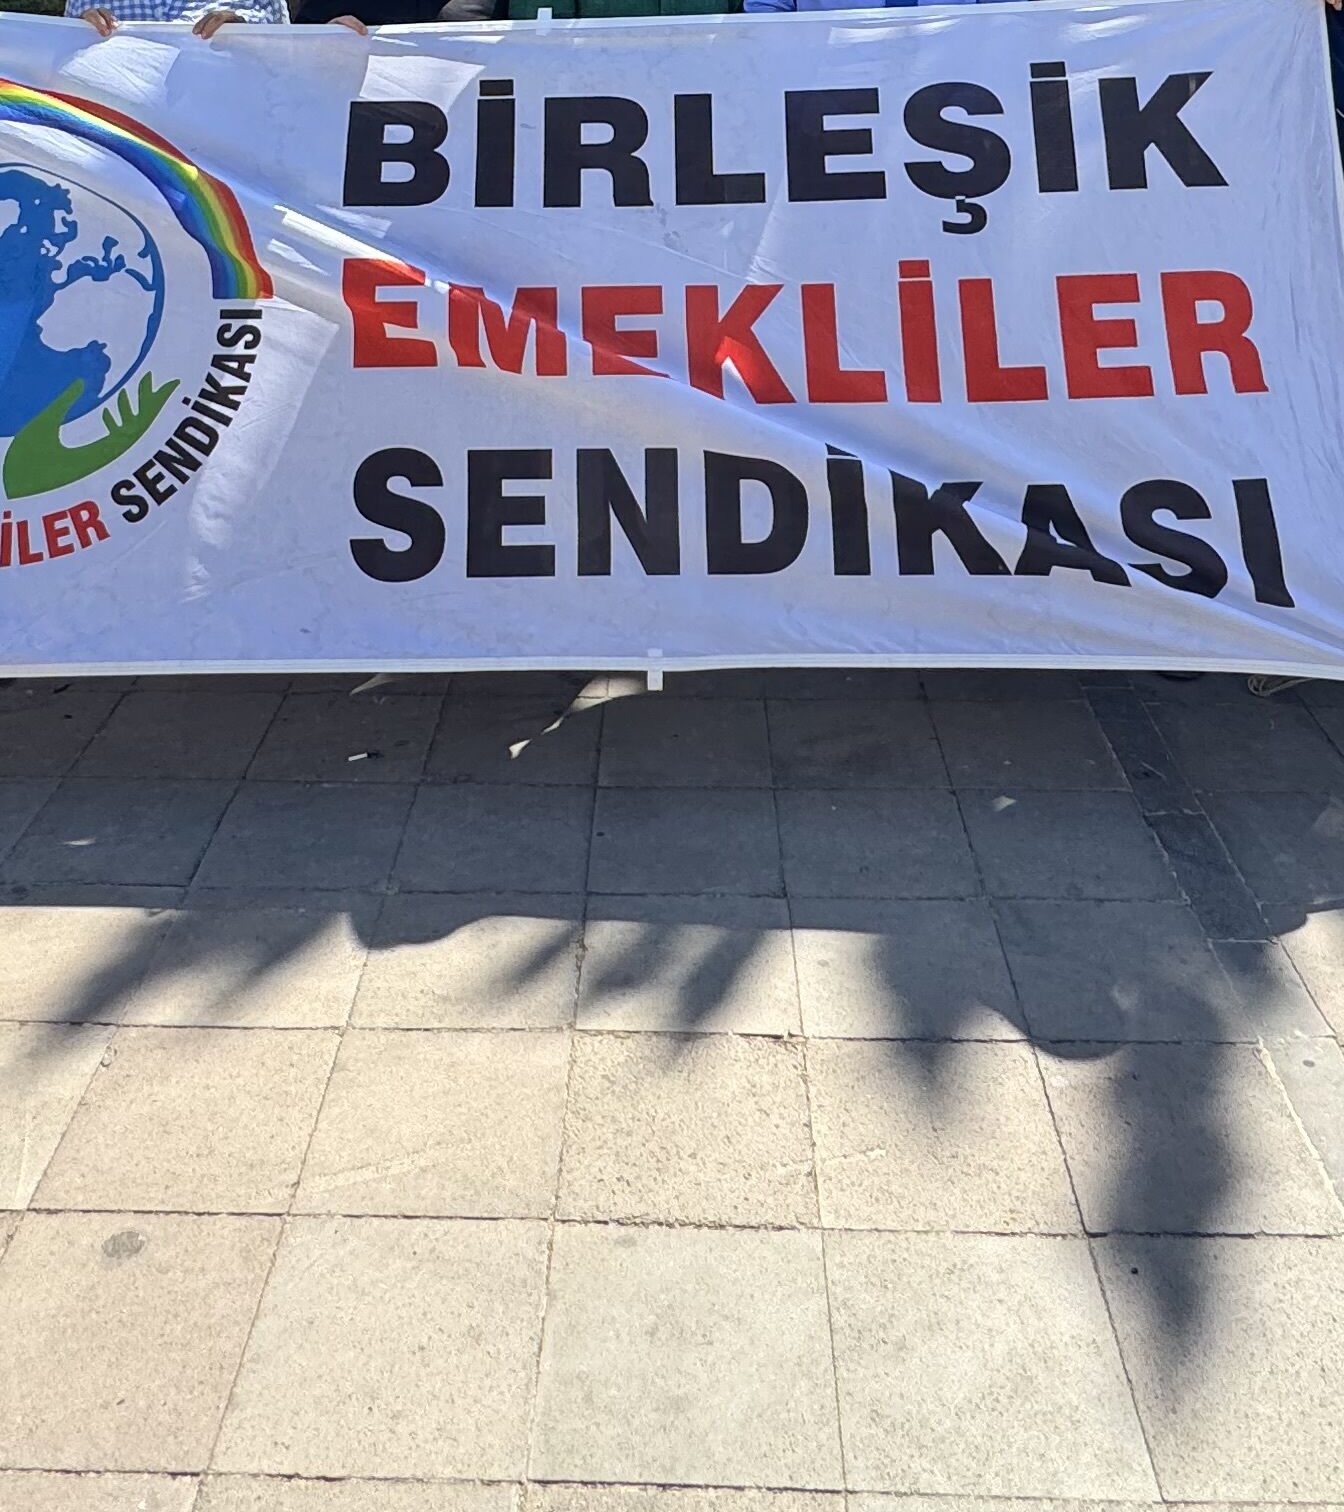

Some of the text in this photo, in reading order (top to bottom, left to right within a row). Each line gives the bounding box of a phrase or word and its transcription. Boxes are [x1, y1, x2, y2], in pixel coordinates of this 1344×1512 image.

[342, 61, 1229, 236] BİRLEŞİK
[110, 308, 263, 523] SENDİKASI
[340, 258, 1270, 406] EMEKLİLER
[348, 443, 1295, 609] SENDİKASI
